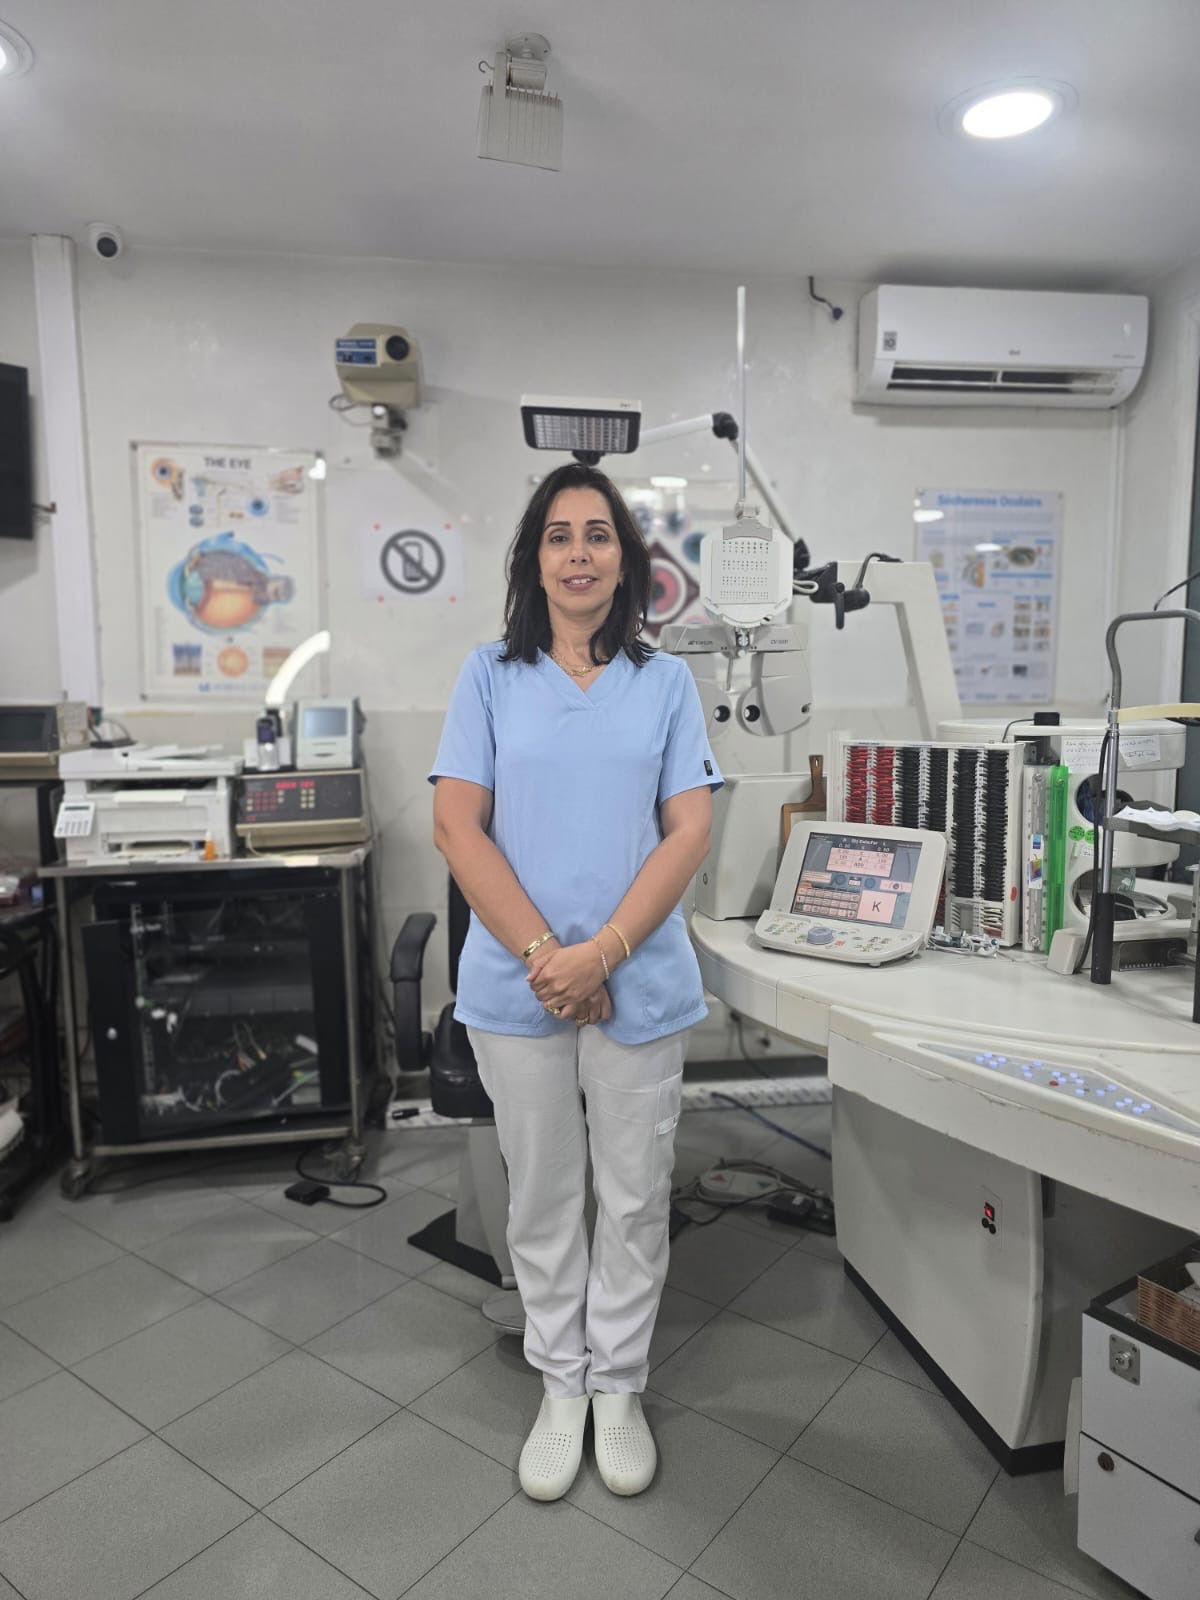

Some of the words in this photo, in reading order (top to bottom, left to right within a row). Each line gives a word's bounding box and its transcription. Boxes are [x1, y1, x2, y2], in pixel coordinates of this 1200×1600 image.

[203, 456, 226, 469] THE
[229, 457, 252, 470] EYE
[872, 901, 882, 912] K
